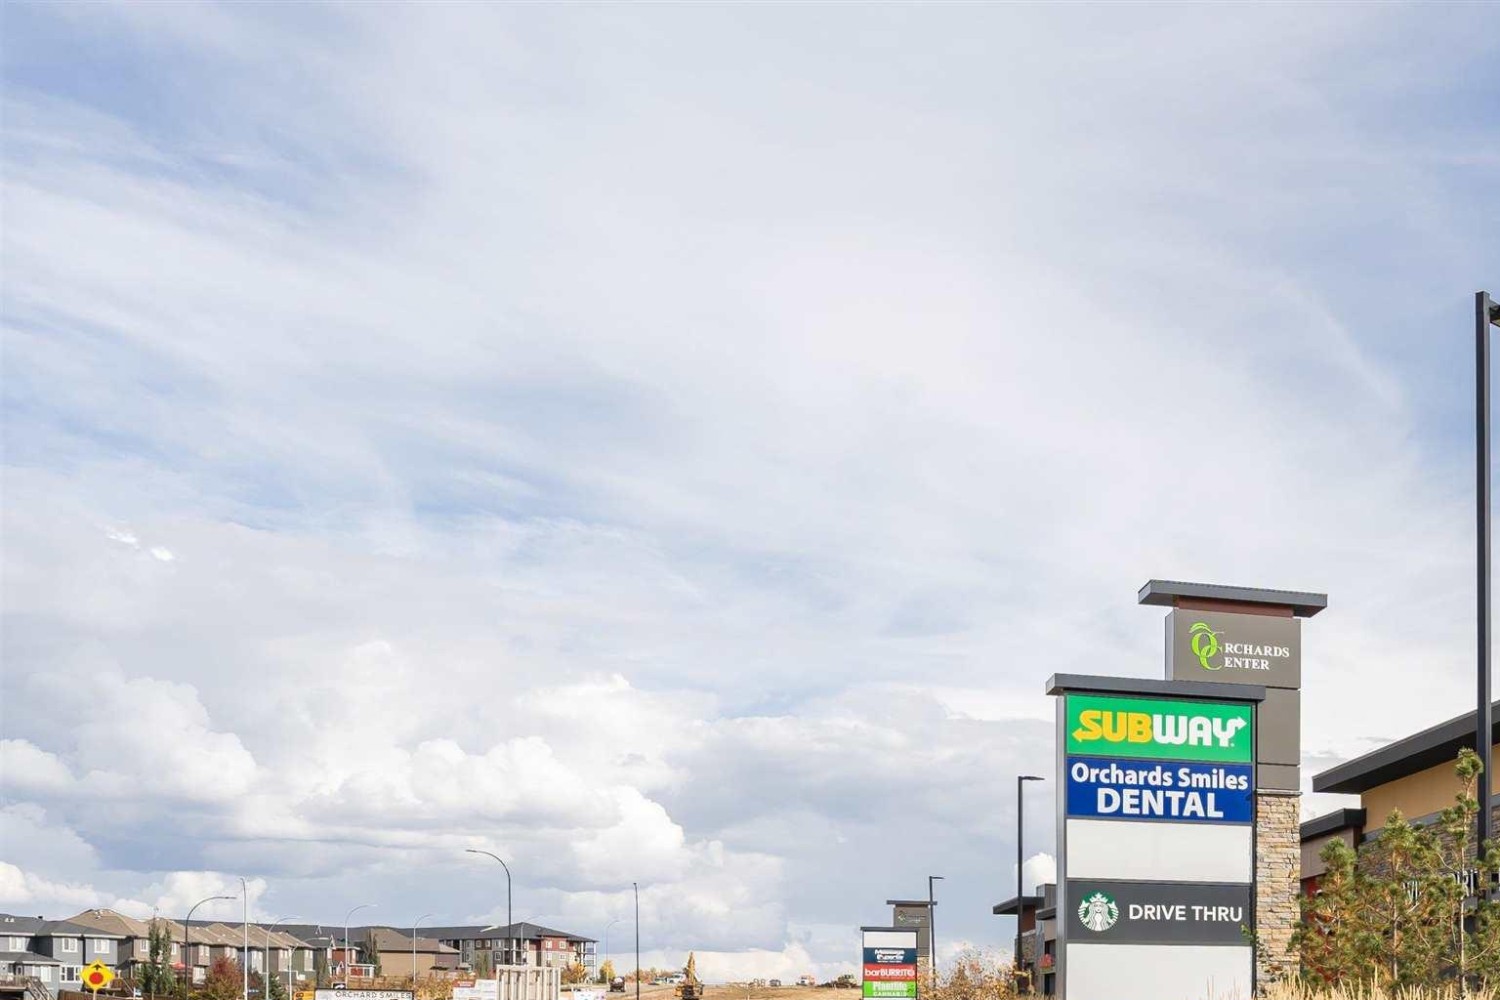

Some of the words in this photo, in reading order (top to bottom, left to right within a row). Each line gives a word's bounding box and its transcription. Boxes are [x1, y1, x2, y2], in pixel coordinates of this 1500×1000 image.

[1072, 710, 1247, 747] SUBWAY
[1071, 762, 1173, 786] Orchards
[1178, 768, 1248, 790] Smiles
[1097, 788, 1224, 818] DENTAL
[1128, 904, 1187, 921] DRIVE
[1191, 905, 1243, 922] THRU
